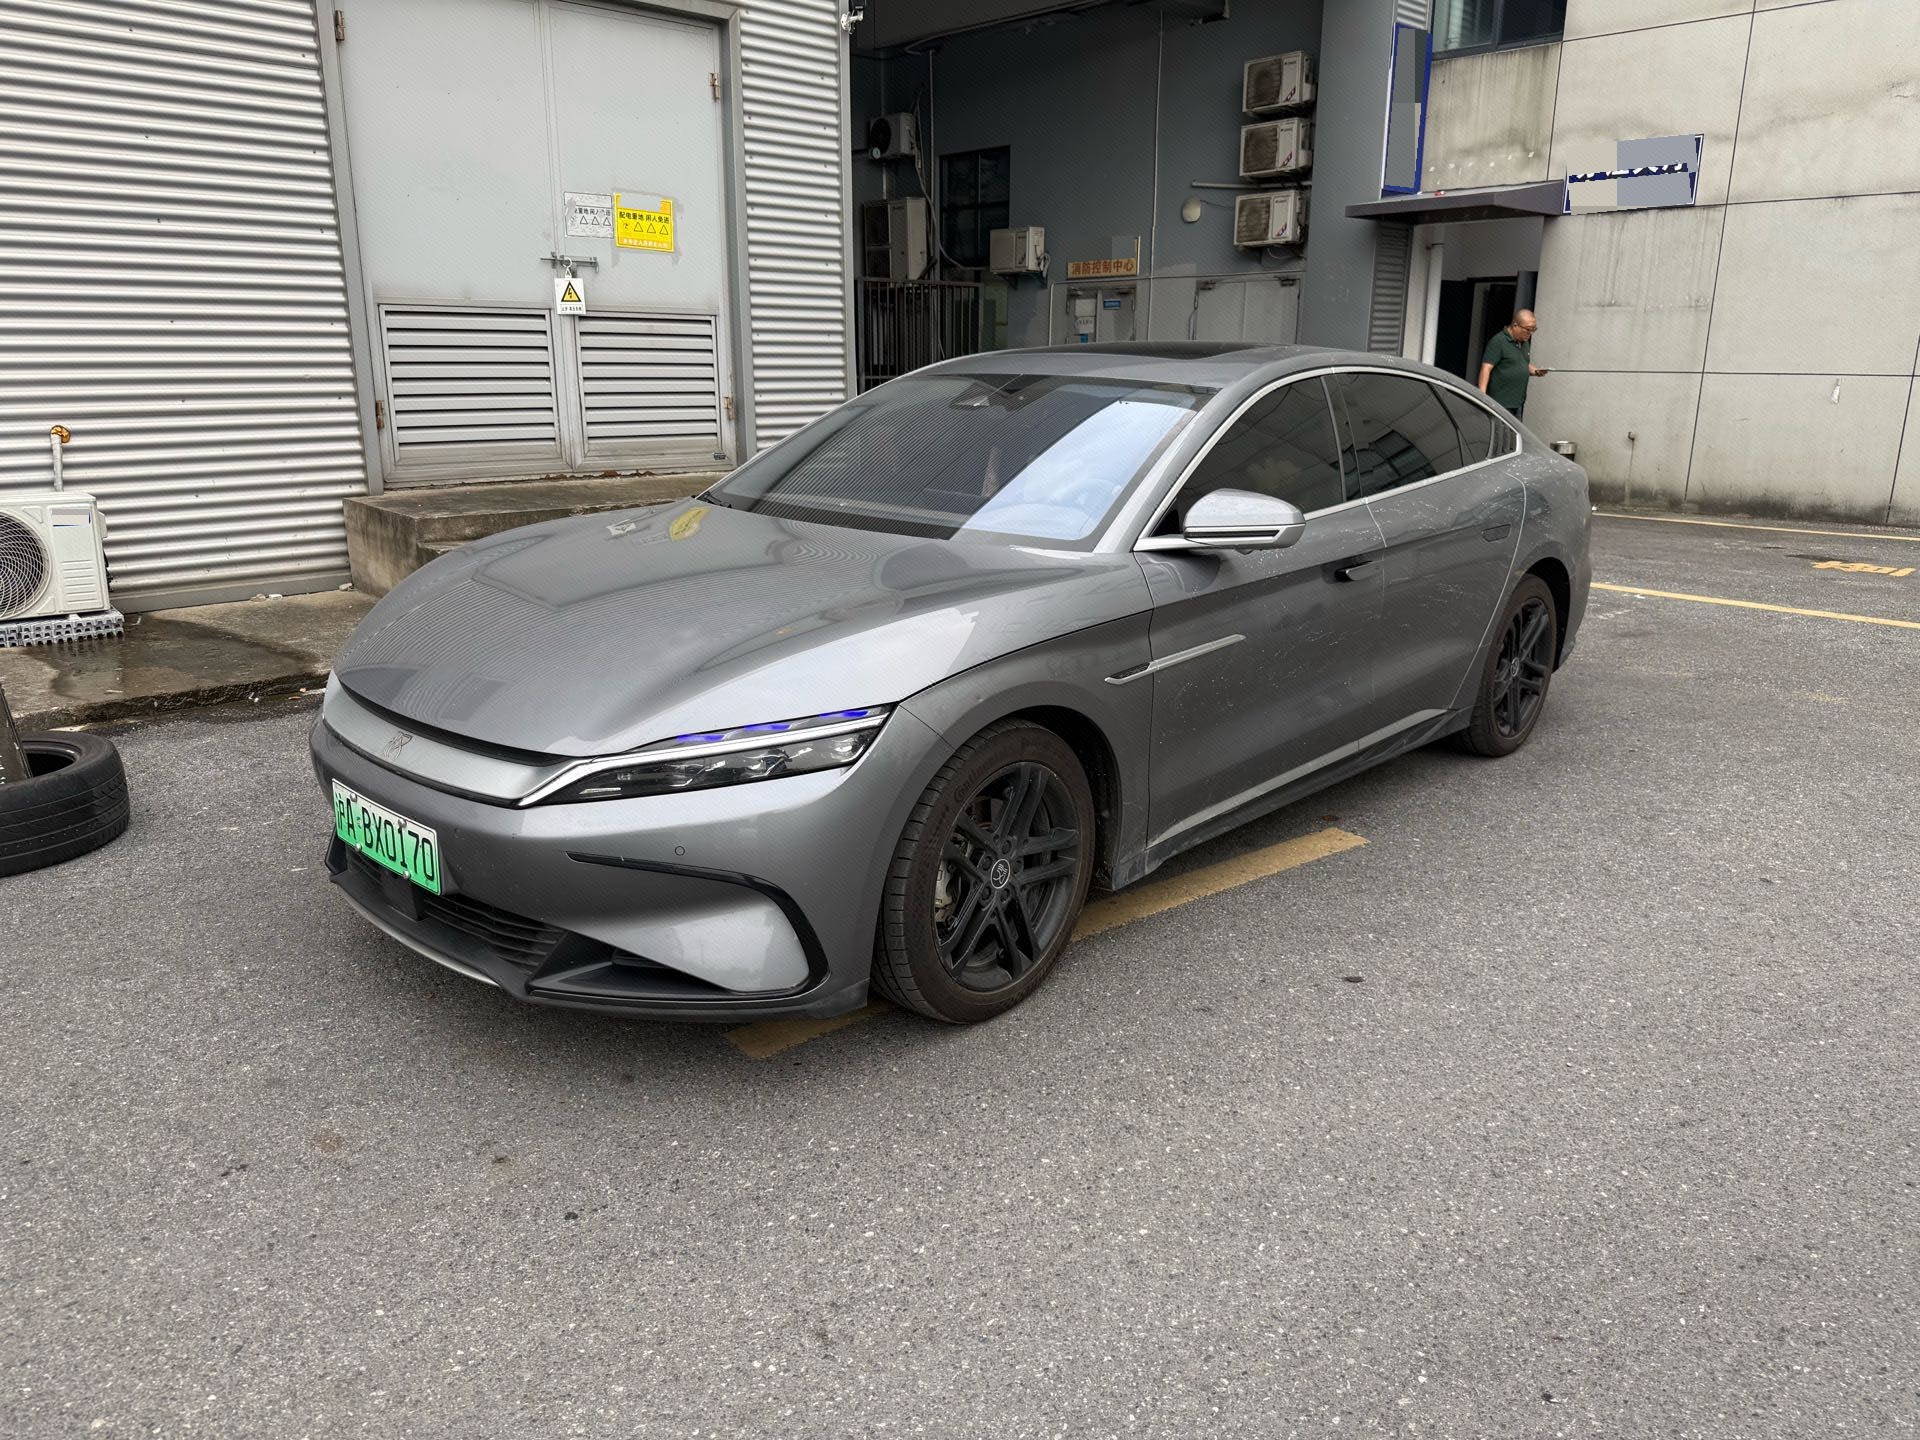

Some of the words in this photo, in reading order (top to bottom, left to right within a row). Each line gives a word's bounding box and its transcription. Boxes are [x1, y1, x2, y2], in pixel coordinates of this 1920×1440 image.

[619, 211, 644, 221] 配电重地
[646, 214, 670, 224] 闲人免进
[1071, 259, 1134, 275] 消防控制中心
